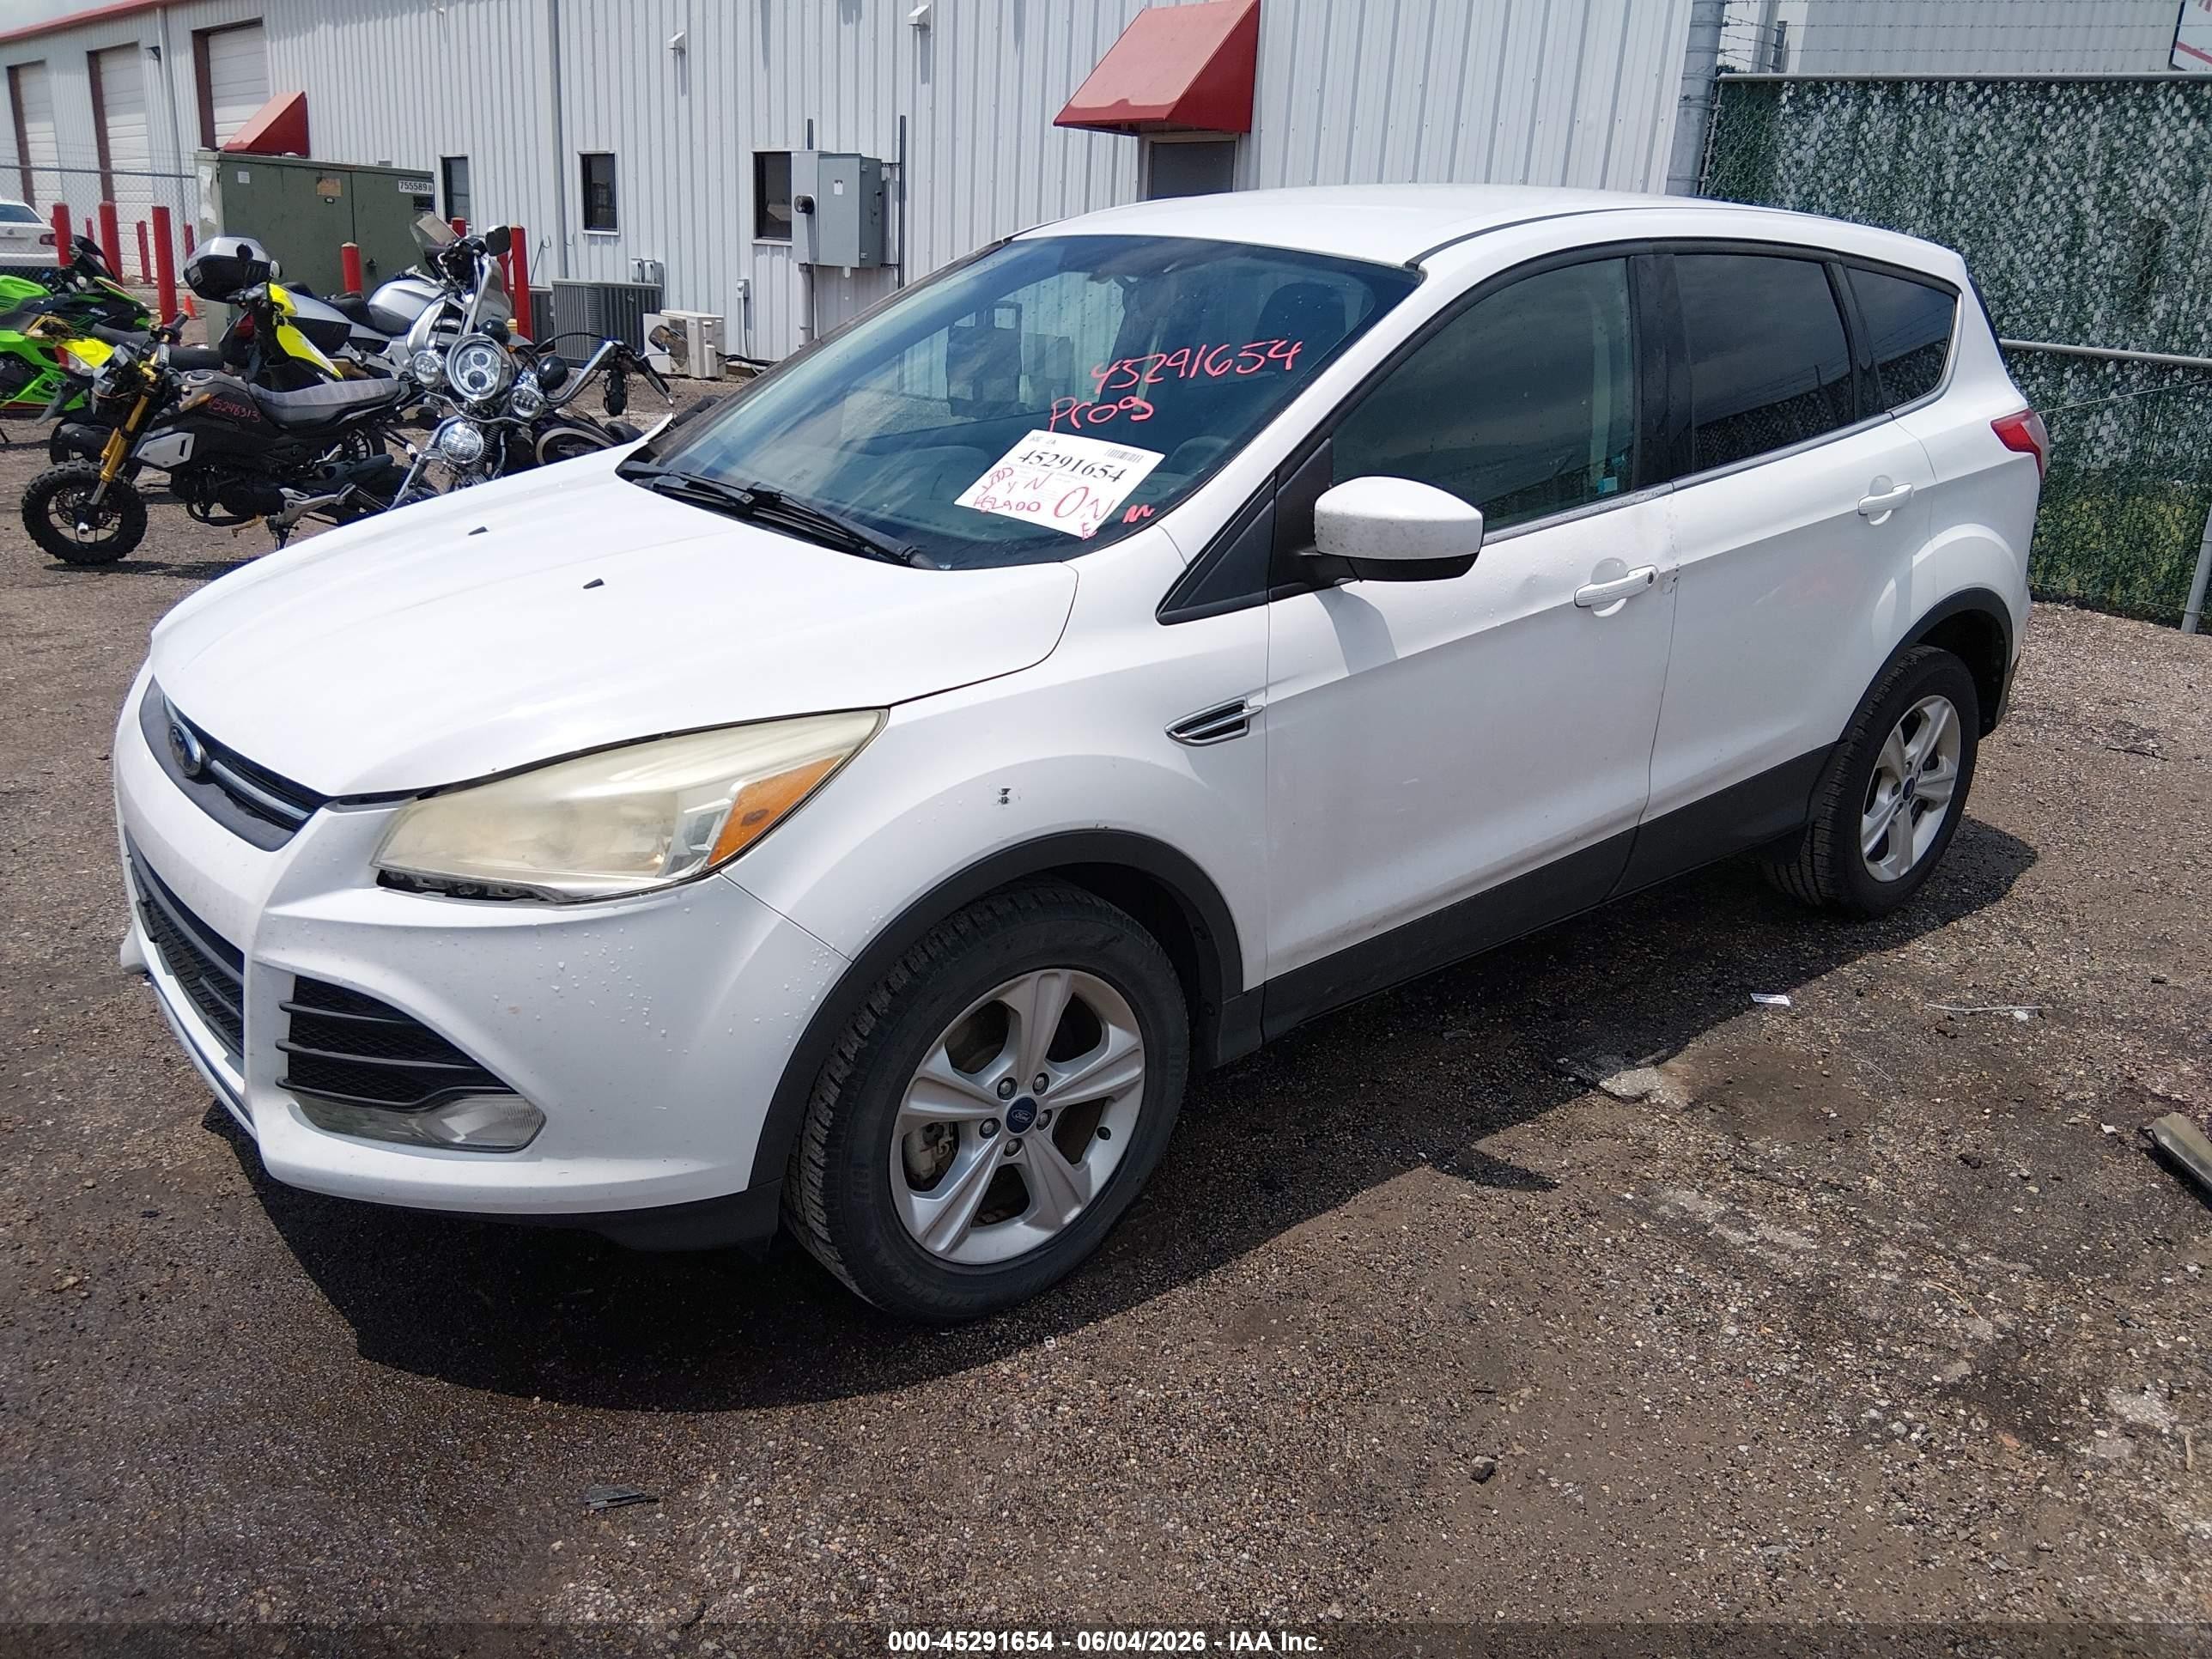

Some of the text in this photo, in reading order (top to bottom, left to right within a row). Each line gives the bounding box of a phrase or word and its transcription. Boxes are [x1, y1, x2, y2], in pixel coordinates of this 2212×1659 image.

[400, 181, 428, 191] 755589
[1090, 339, 1304, 395] 45291654
[1018, 449, 1127, 483] 45291654
